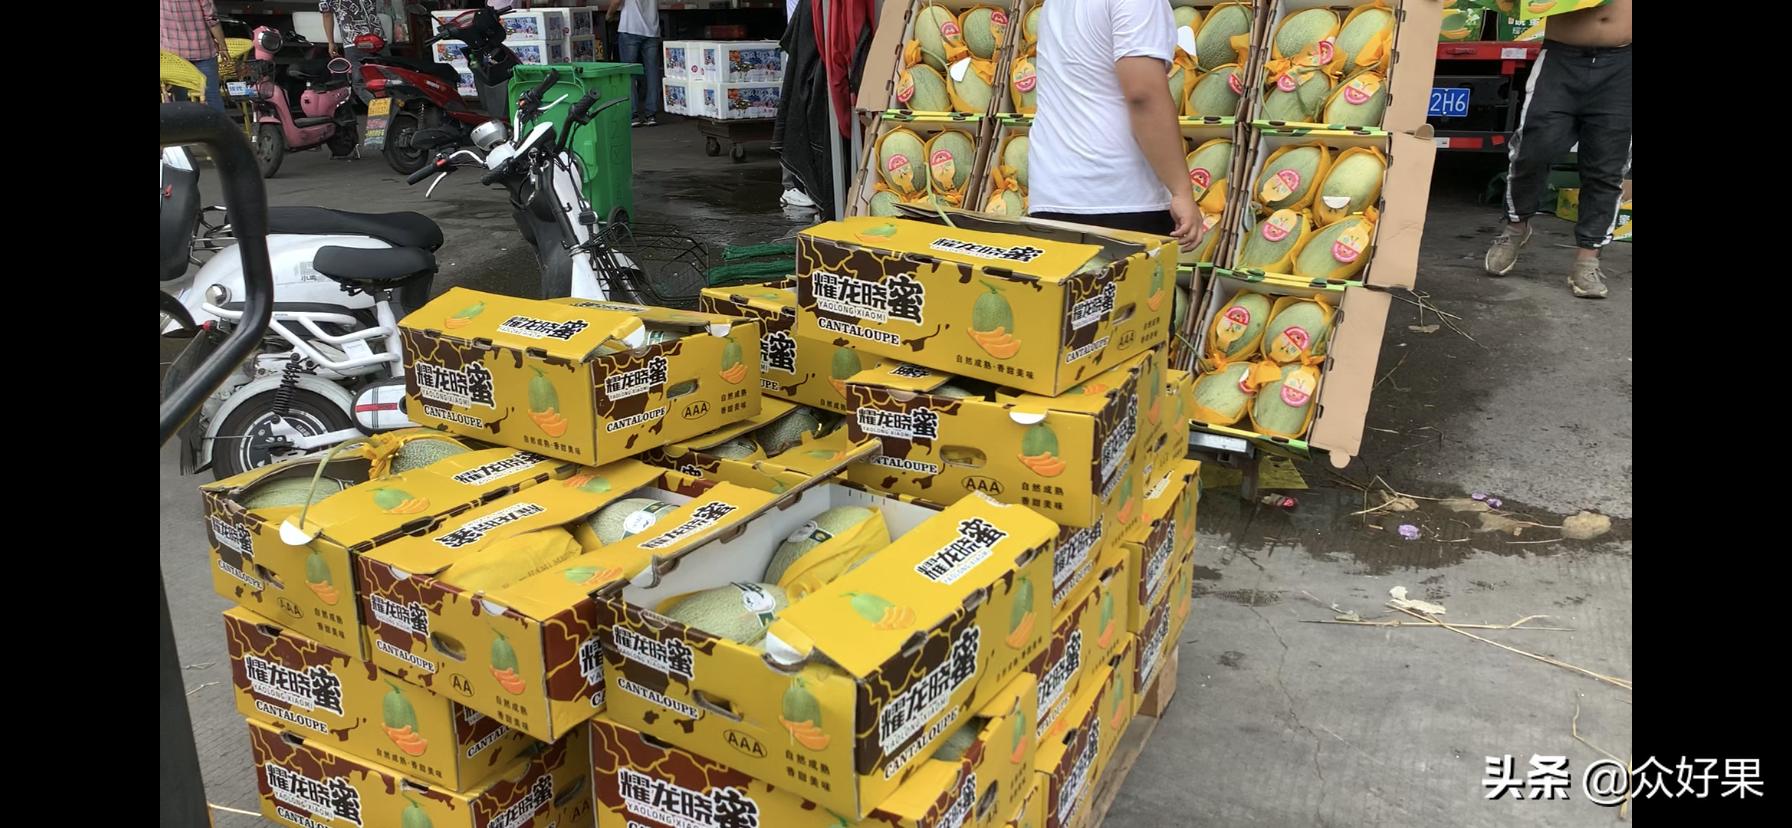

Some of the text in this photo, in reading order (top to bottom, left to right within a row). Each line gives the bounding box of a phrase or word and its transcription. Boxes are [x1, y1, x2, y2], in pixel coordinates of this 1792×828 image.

[1430, 93, 1466, 112] 2H6
[814, 273, 924, 323] 耀龙晓蜜
[818, 318, 899, 345] CANTALOUPE
[416, 363, 494, 408] 耀龙晓蜜
[606, 354, 667, 393] 耀龙晓蜜
[424, 406, 483, 428] CANTALOUPE
[606, 408, 666, 432] CANTALOUPE
[684, 401, 708, 418] AAA
[859, 408, 938, 438] 耀龙晓蜜
[965, 479, 1001, 494] AAA
[917, 518, 1006, 581] 耀龙晓蜜
[372, 596, 428, 635] 耀龙晓蜜
[377, 641, 435, 672] CANTALOUPE
[614, 627, 693, 678] 耀龙晓蜜
[247, 656, 342, 714] 耀龙晓蜜
[452, 676, 472, 693] AA
[618, 679, 697, 718] CANTALOUPE
[881, 628, 979, 741] 耀龙晓蜜
[256, 701, 328, 733] CANTALOUPE
[727, 732, 764, 756] AAA
[267, 764, 361, 825] 耀龙晓蜜
[620, 771, 757, 828] 耀龙晓蜜
